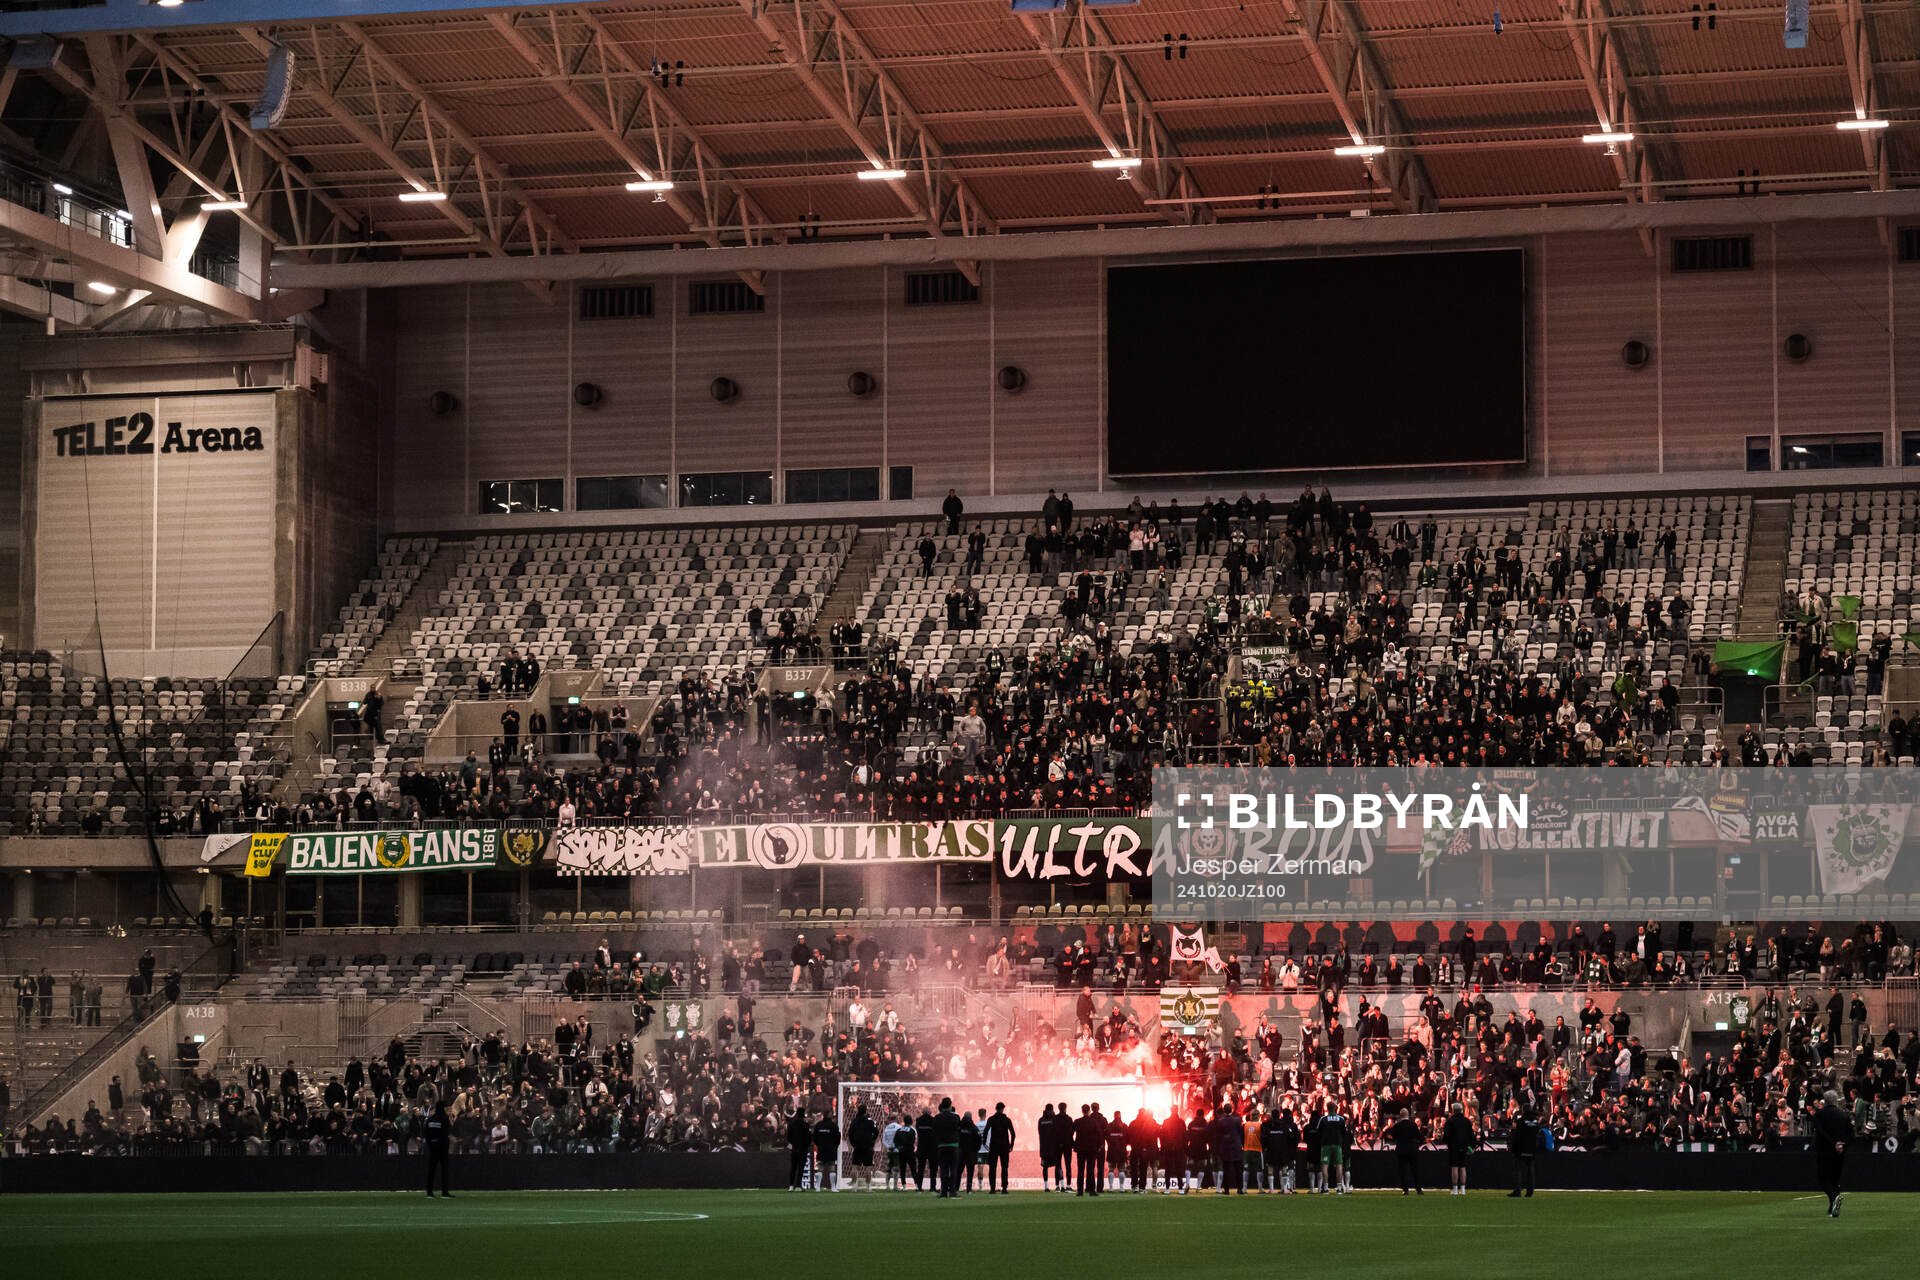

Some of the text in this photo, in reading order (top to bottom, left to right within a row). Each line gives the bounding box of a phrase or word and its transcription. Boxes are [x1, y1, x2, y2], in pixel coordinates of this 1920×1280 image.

[53, 412, 264, 457] TELE2 Arena
[785, 669, 813, 681] B337
[341, 681, 367, 693] B338
[1530, 801, 1569, 817] DEFEND
[1755, 811, 1799, 828] AVGÅ
[1755, 826, 1799, 840] ALLA
[254, 838, 279, 848] BAJE
[291, 829, 480, 868] BAJEN FANS
[482, 828, 496, 860] 1981
[809, 822, 990, 861] ULTRAS
[1000, 820, 1177, 880] ULTRA
[186, 1006, 215, 1018] A138
